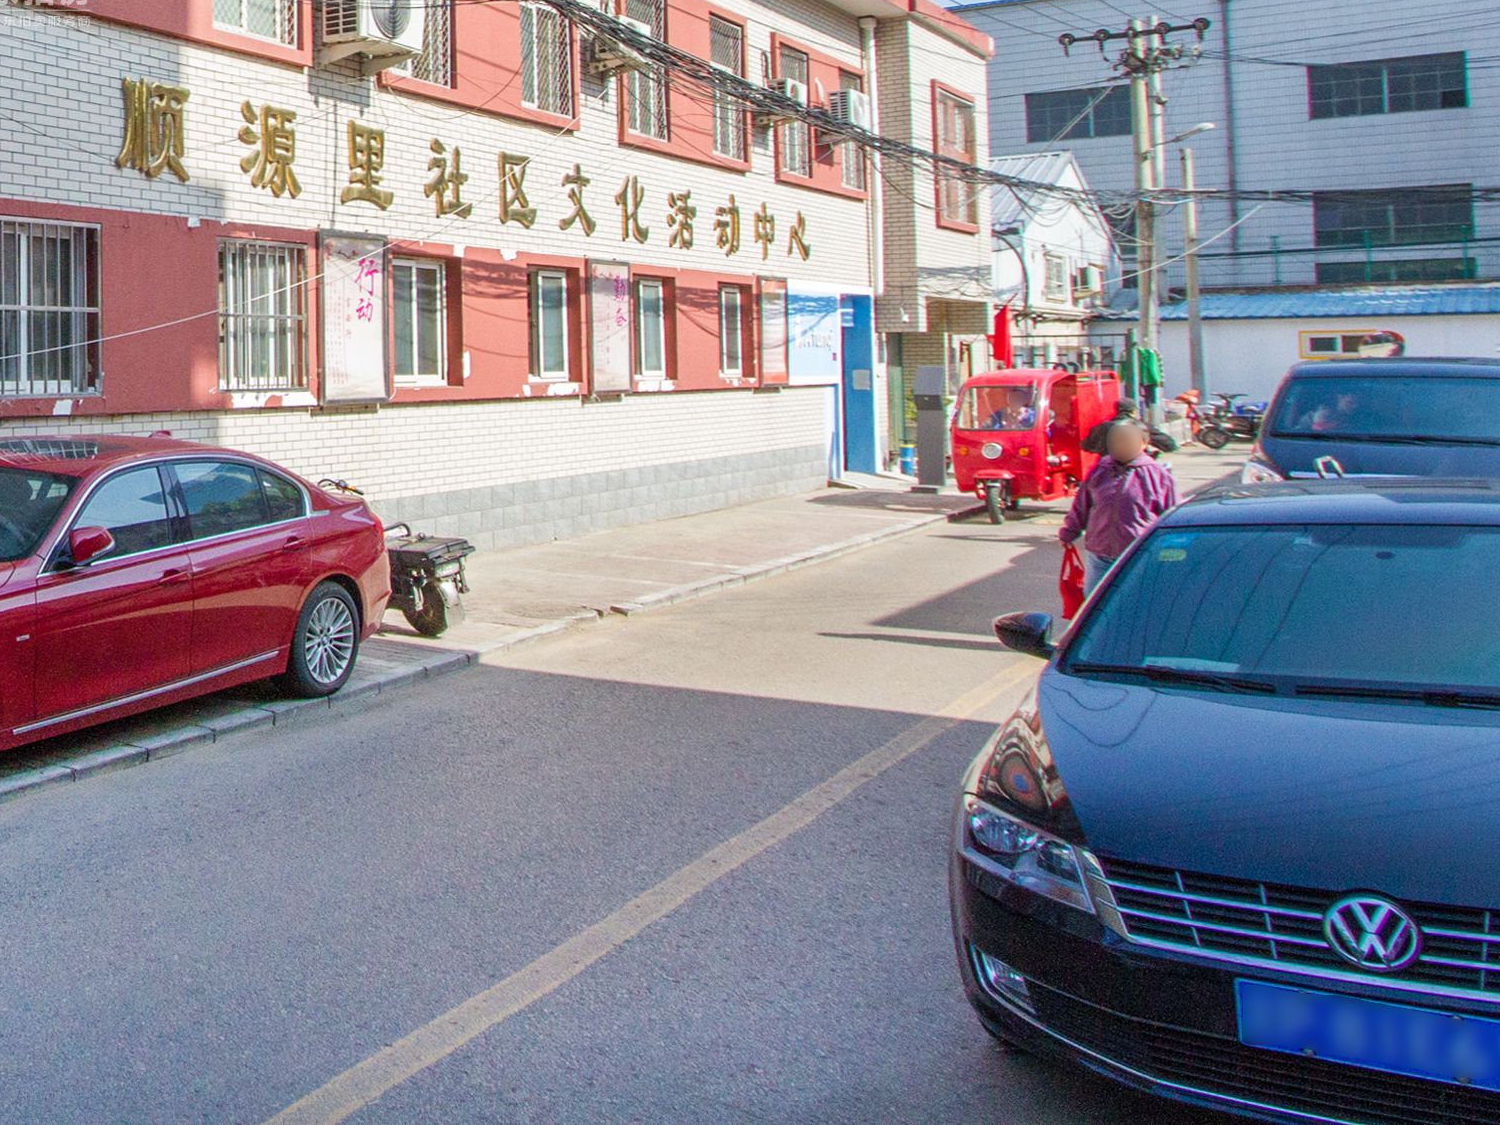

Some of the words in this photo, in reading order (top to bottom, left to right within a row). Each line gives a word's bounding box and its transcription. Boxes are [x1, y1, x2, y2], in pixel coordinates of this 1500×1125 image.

[114, 76, 811, 264] 顺源里社区文化活动中心
[354, 257, 380, 323] 行动
